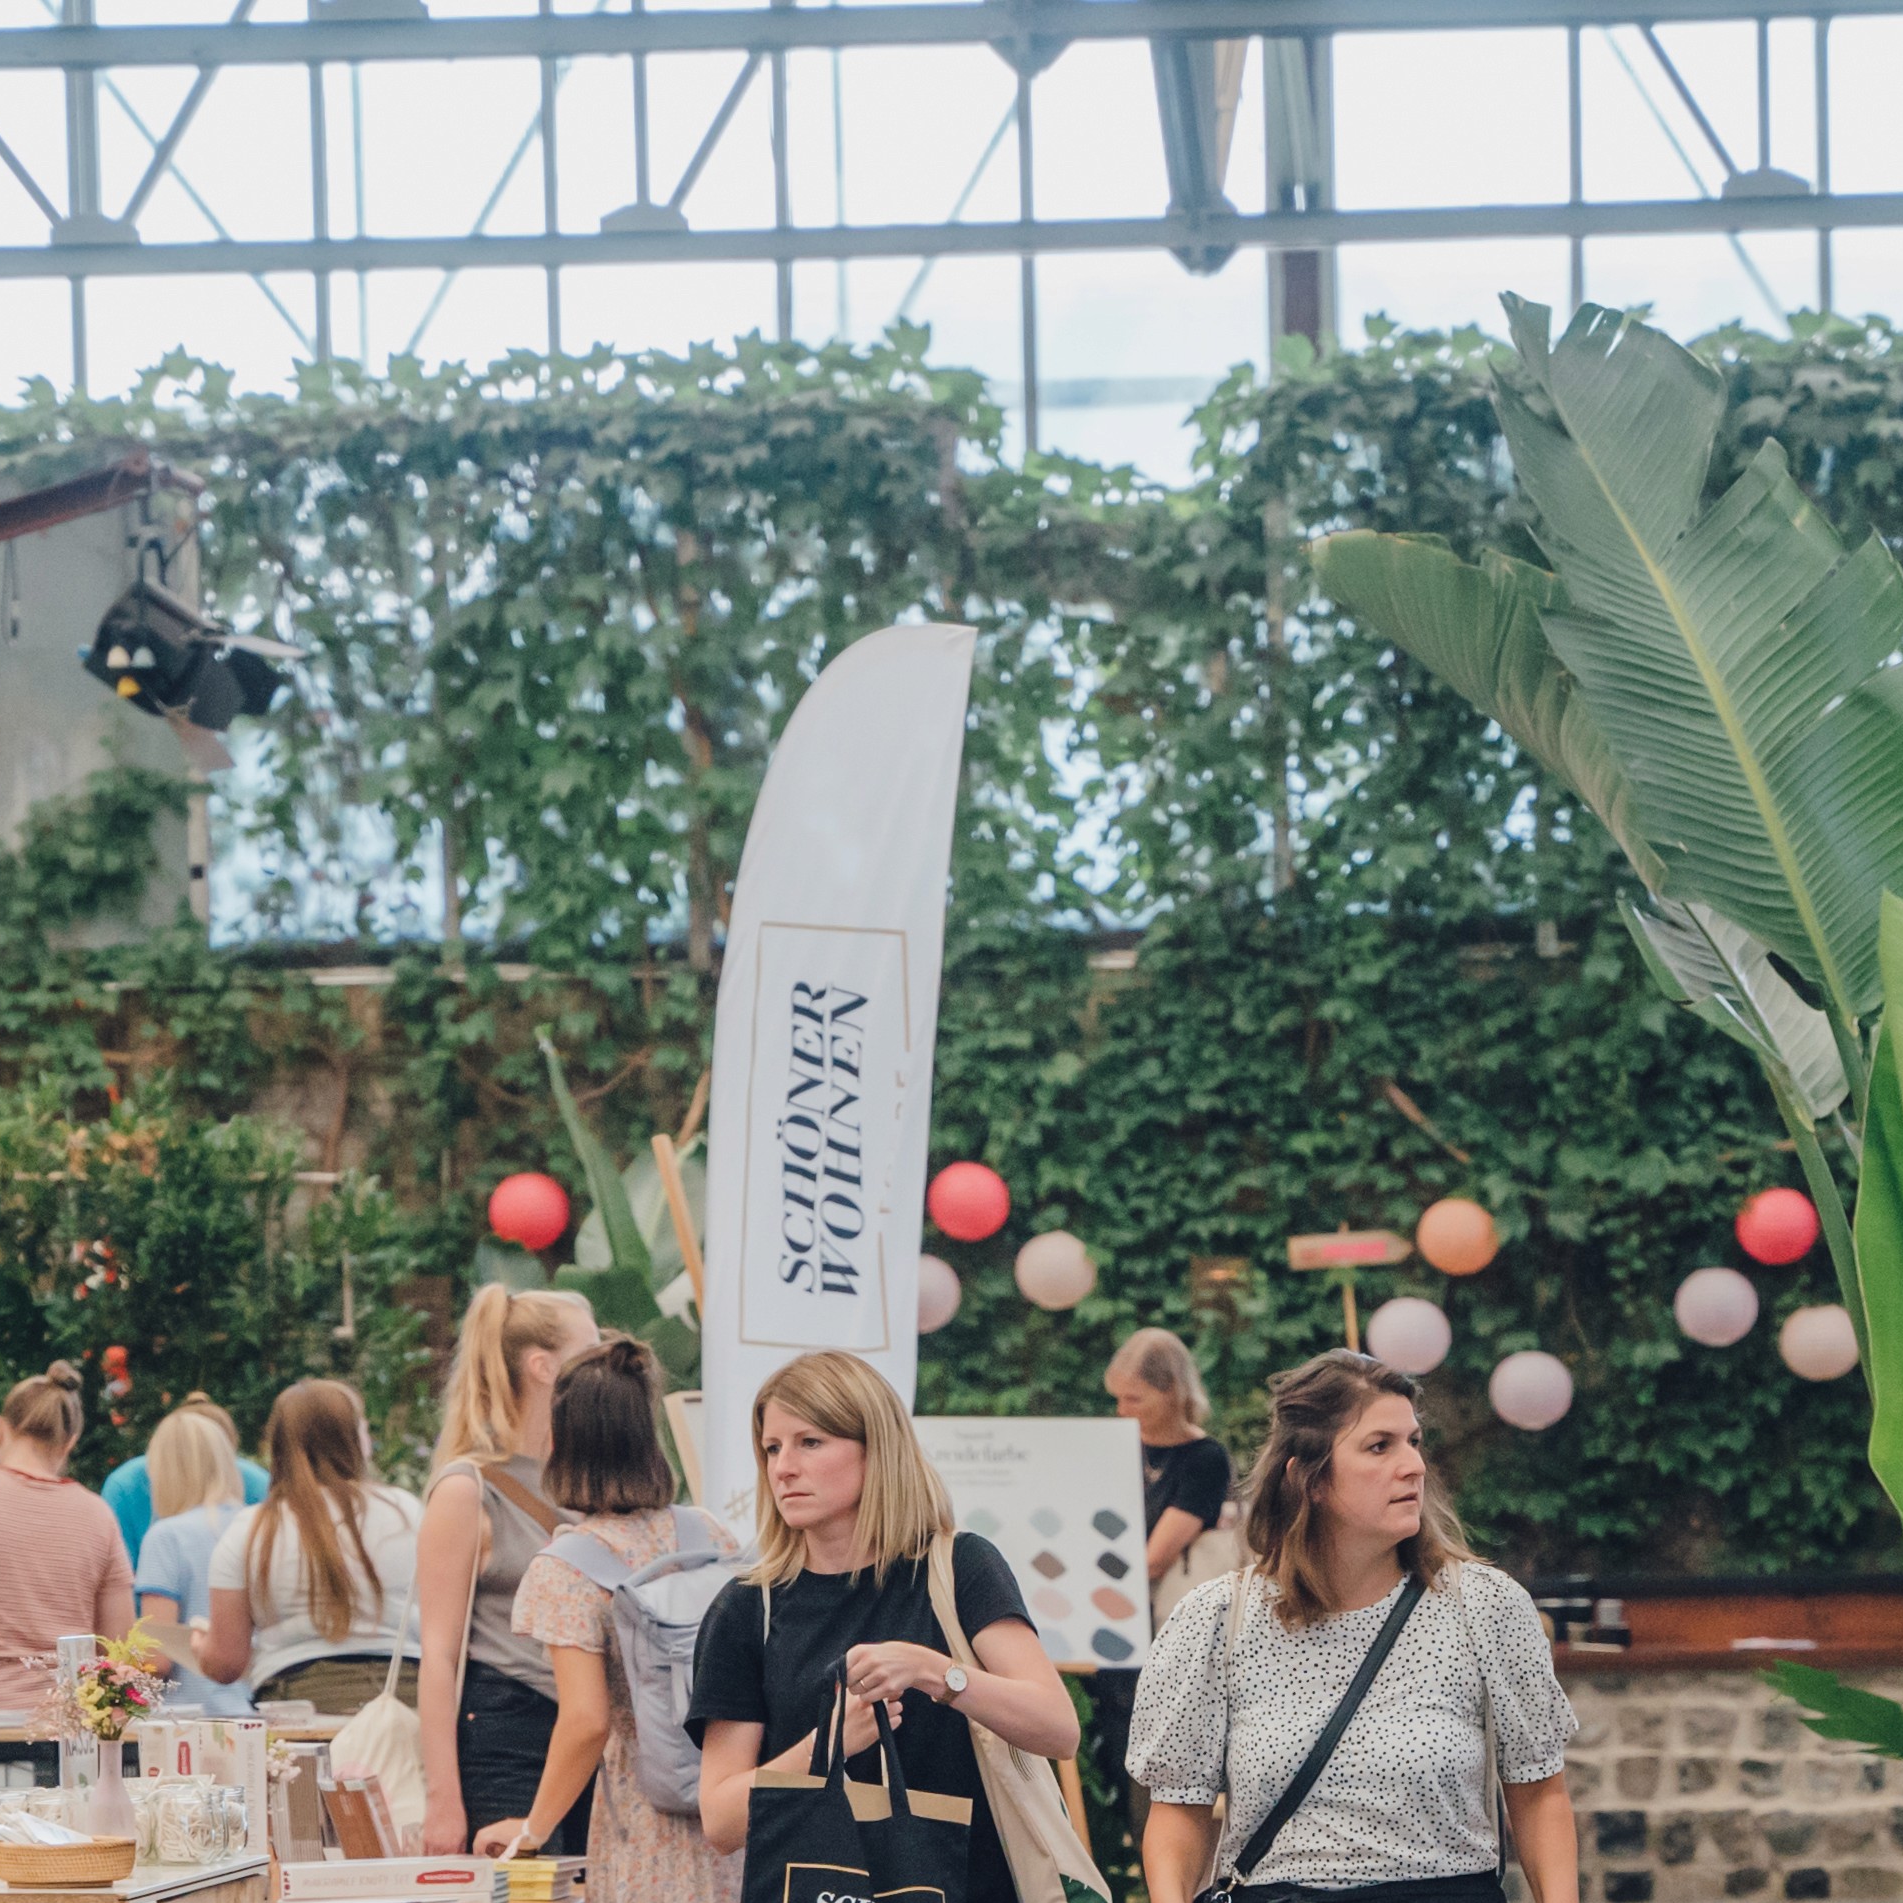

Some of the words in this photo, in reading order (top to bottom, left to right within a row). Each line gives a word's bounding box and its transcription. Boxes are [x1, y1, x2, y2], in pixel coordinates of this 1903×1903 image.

[775, 978, 832, 1295] SCHÖNER
[817, 985, 869, 1301] WOHNEN
[238, 1722, 263, 1731] TOPP
[283, 1870, 291, 1897] TOPP
